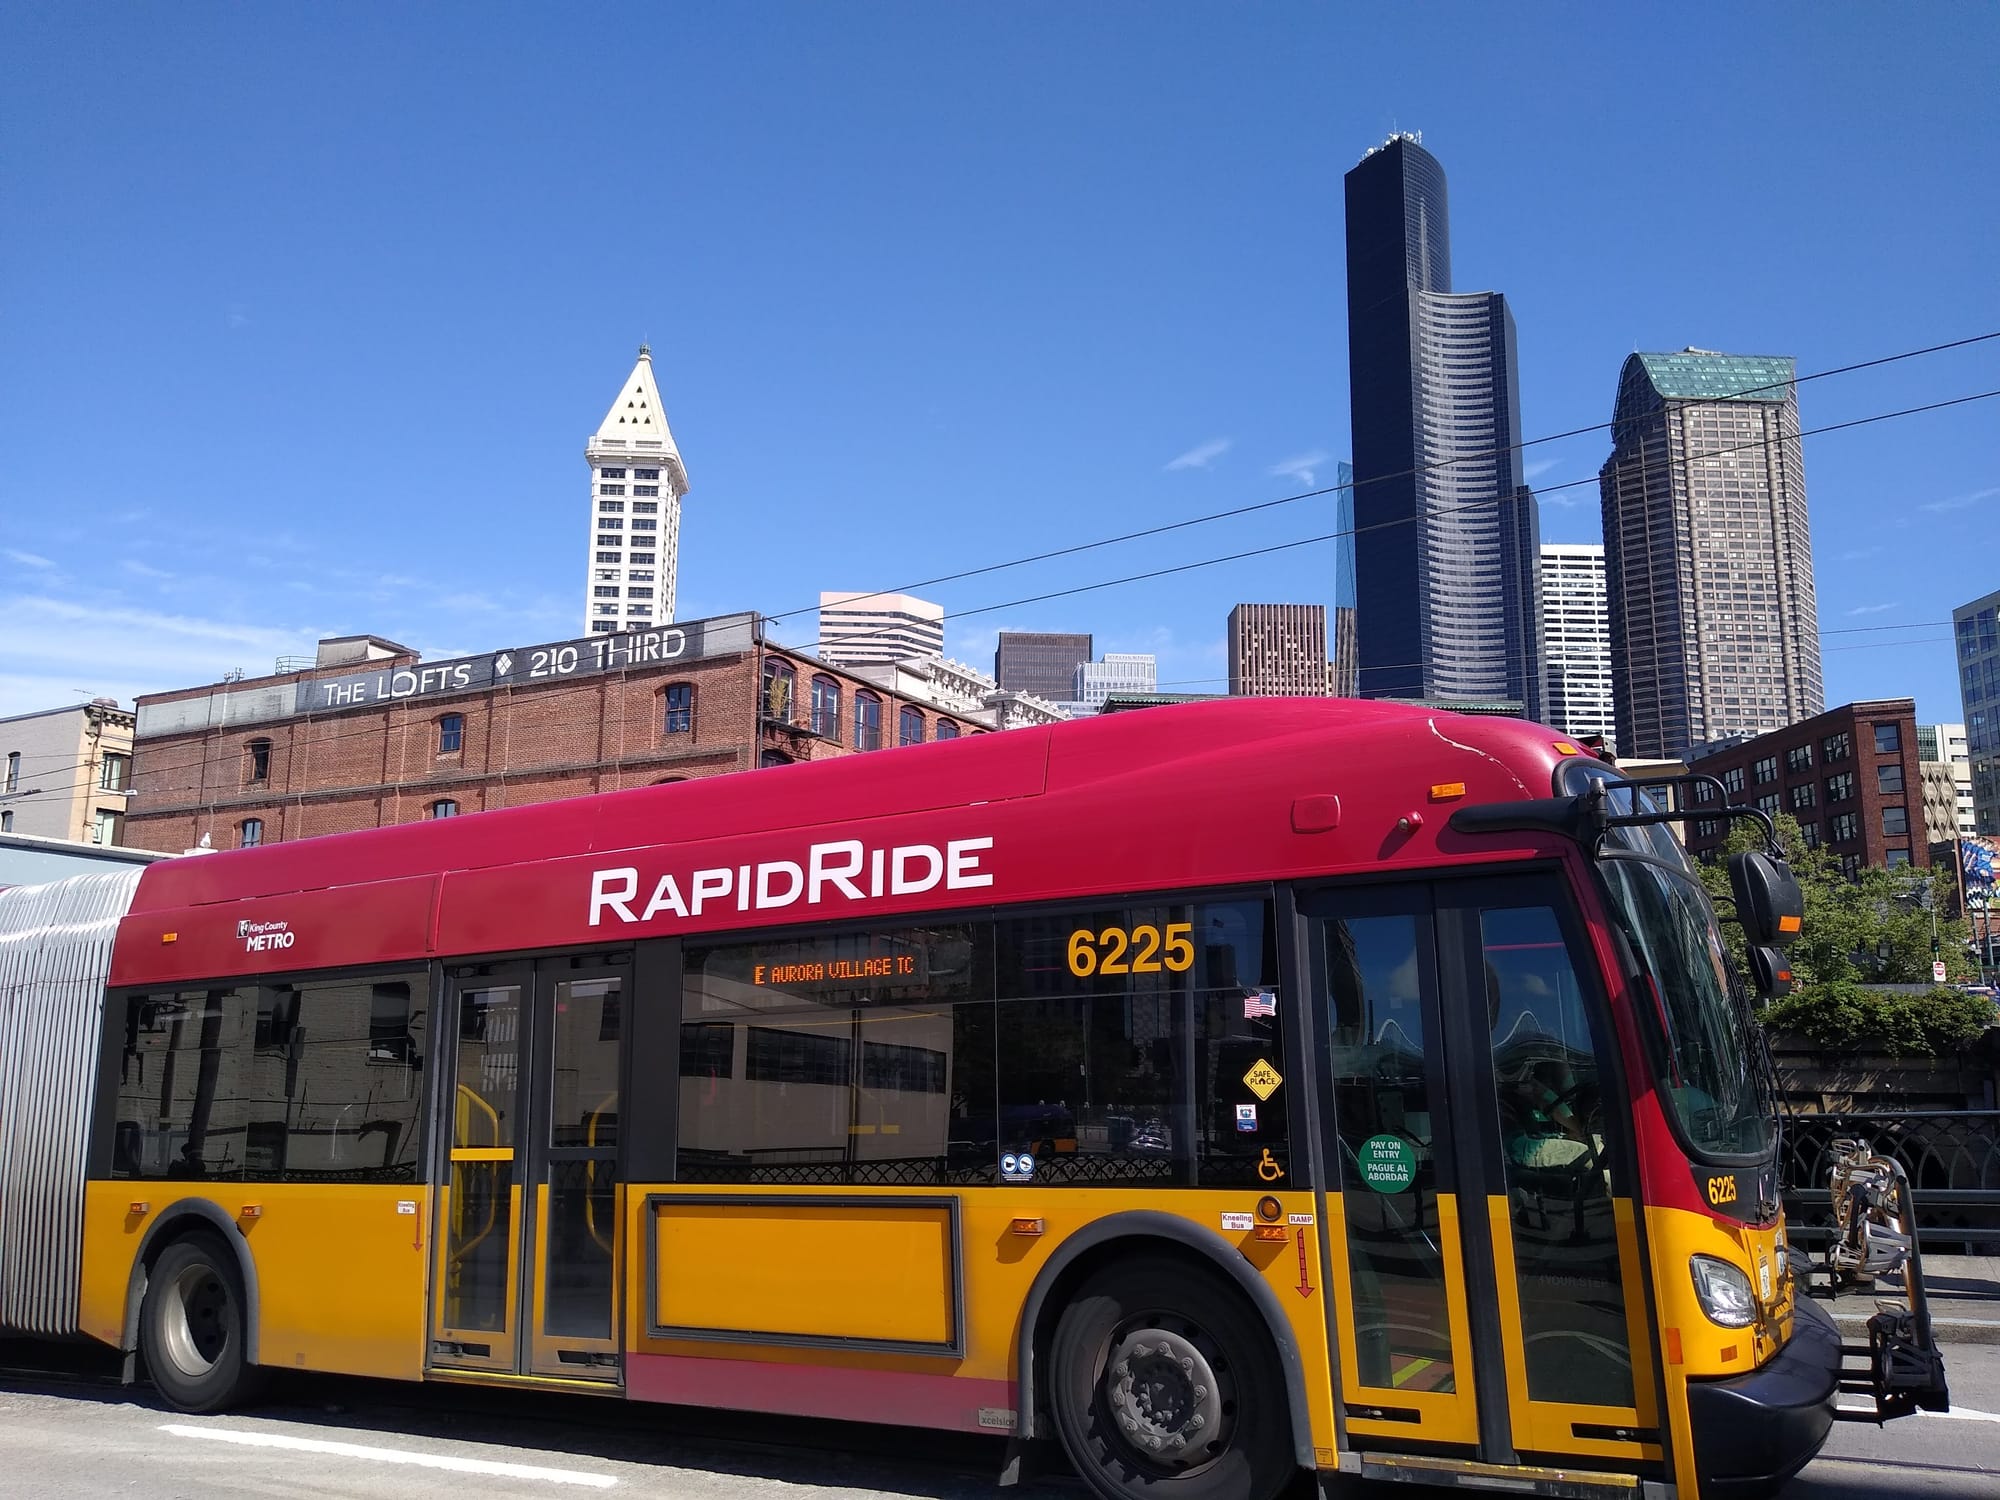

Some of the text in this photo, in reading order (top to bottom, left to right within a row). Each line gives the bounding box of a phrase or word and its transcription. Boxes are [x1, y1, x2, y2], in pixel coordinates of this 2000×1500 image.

[323, 628, 687, 706] THE LOFTS 210 THIRD
[250, 921, 288, 934] King County
[246, 931, 295, 952] METRO
[1067, 922, 1195, 977] 6225
[754, 956, 914, 985] E AURORA VILLAGE TC
[1253, 1070, 1271, 1078] SAFE
[1370, 1141, 1401, 1150] PAY ON
[1373, 1150, 1400, 1159] ENTRY
[1367, 1163, 1409, 1173] PAGUE AL
[1367, 1172, 1409, 1182] ABORDAR
[1707, 1175, 1737, 1205] 6225
[1222, 1213, 1253, 1223] Kneeling
[1290, 1215, 1313, 1223] RAMP
